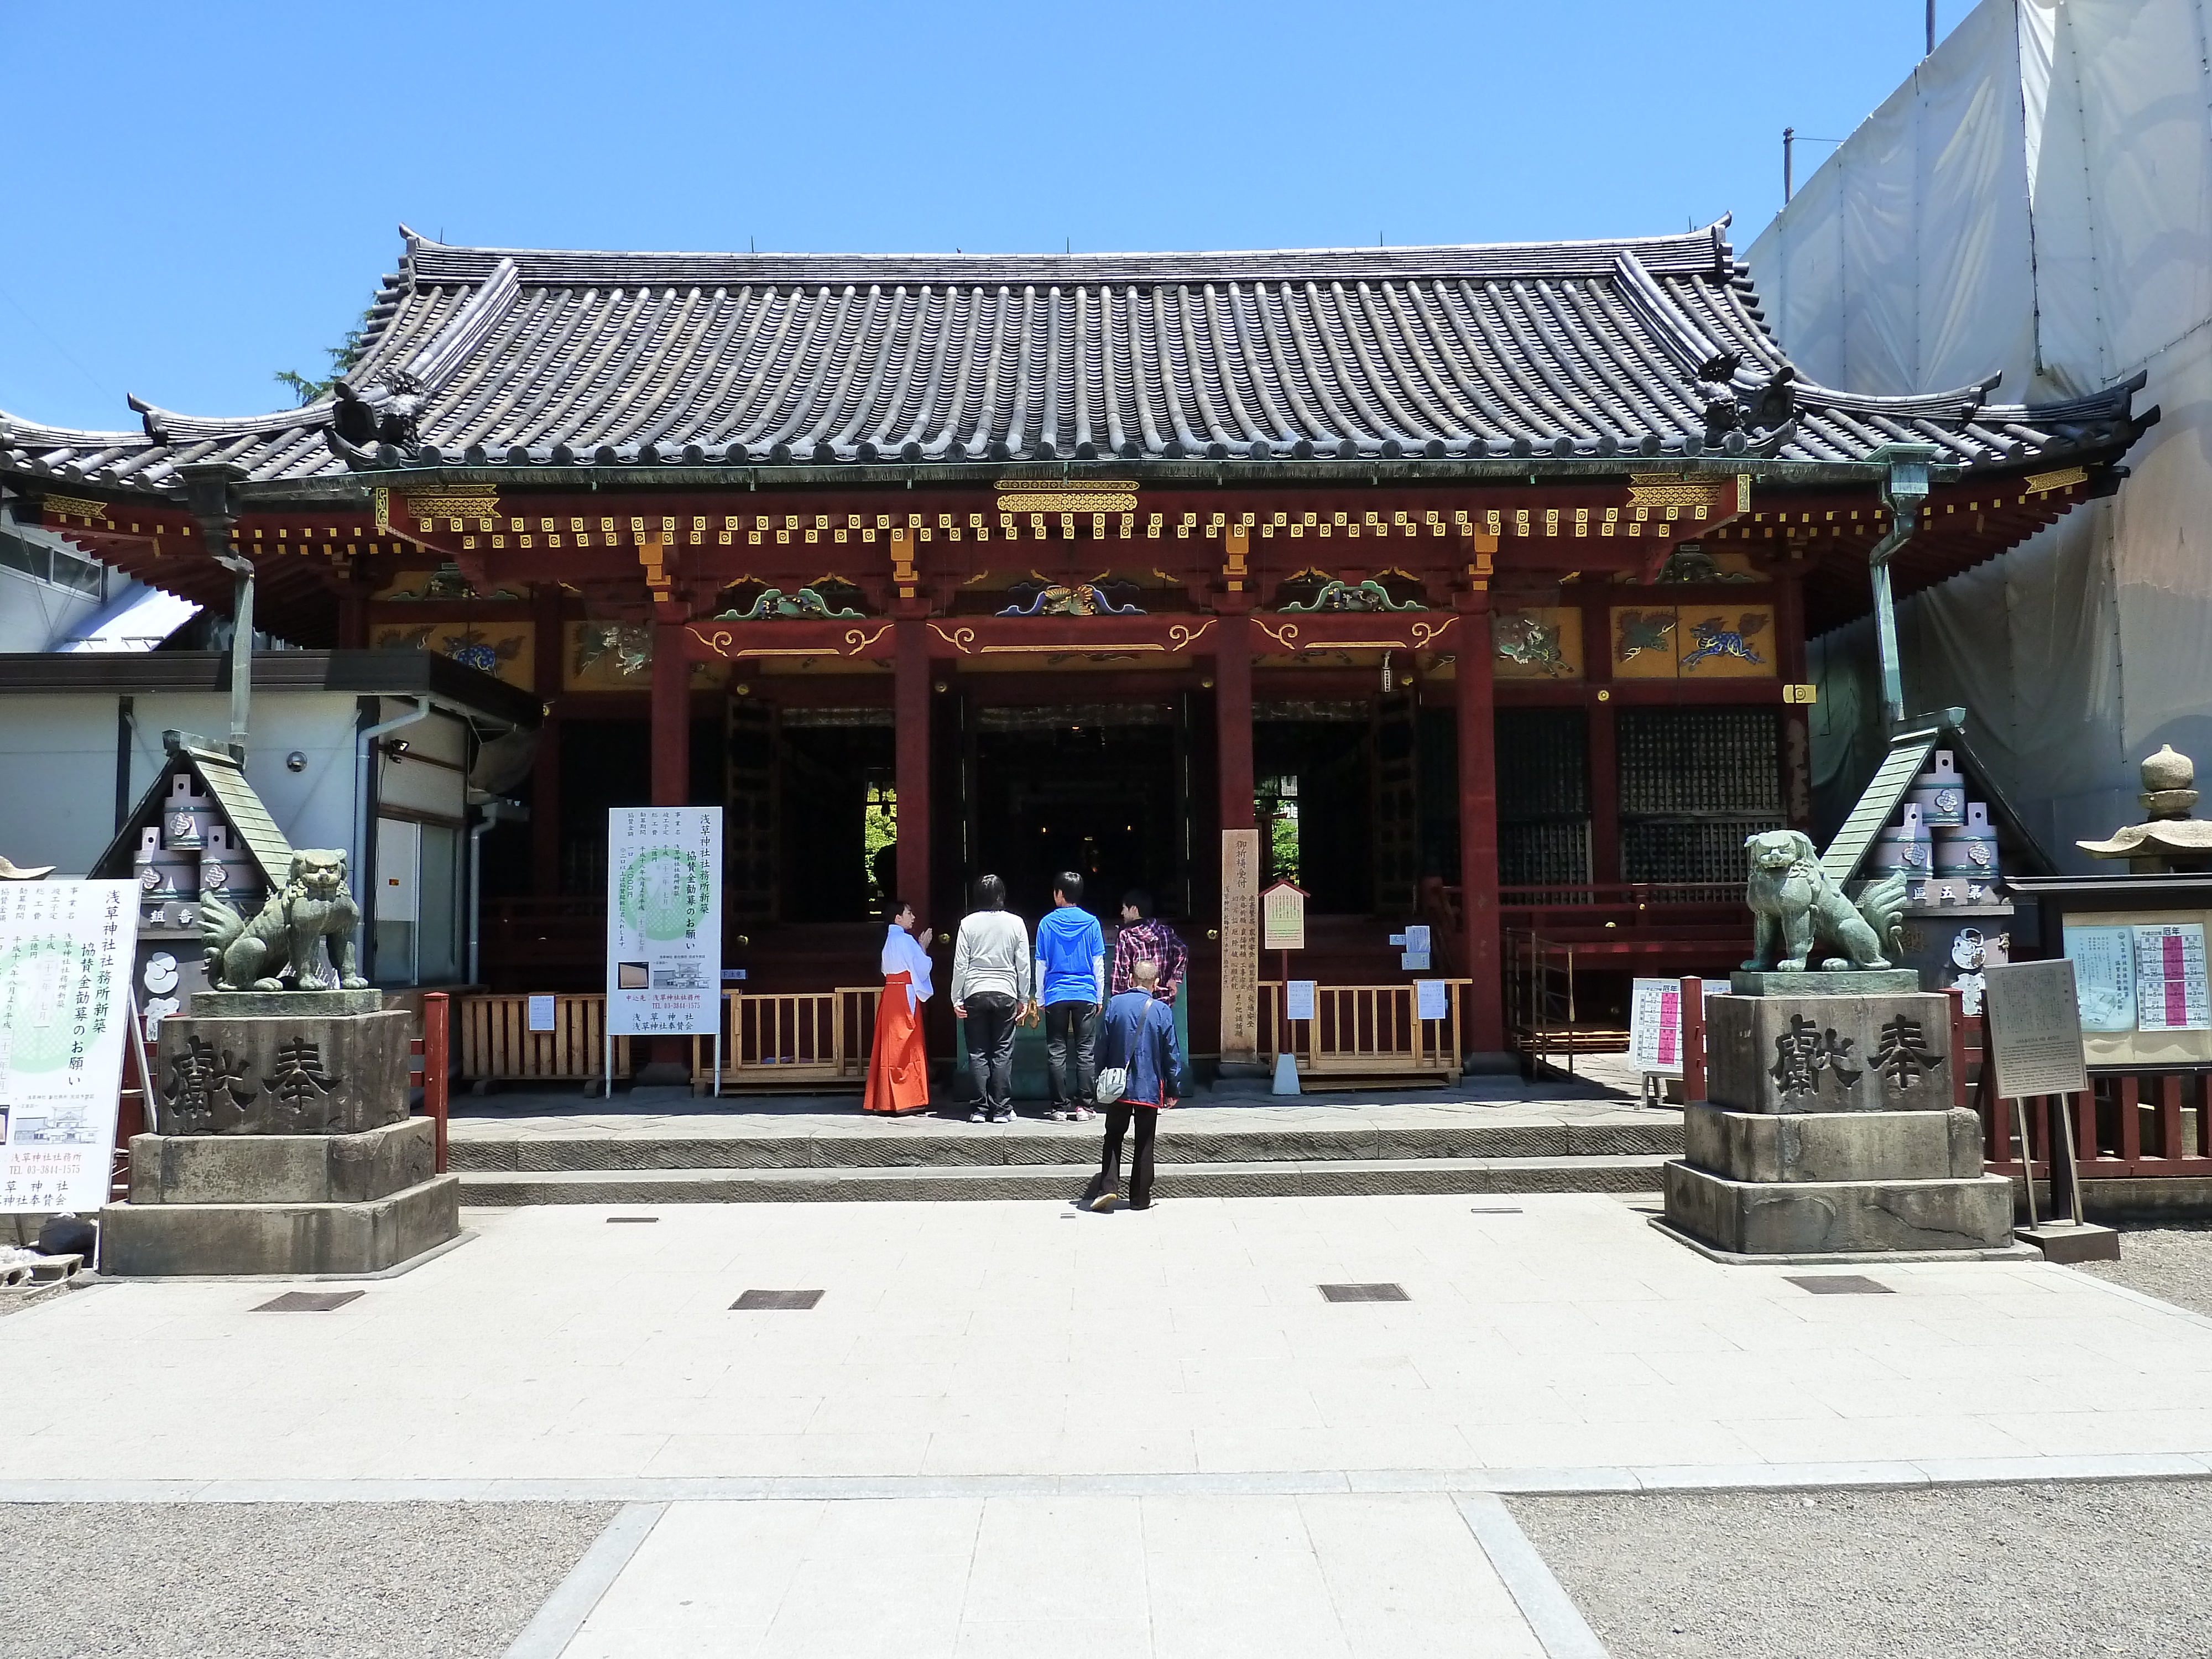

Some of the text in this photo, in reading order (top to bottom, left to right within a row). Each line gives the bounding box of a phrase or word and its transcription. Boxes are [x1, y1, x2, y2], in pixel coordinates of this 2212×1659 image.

[699, 813, 710, 914] 浅草神社社務所新築
[685, 851, 697, 950] 協賛金勧募のお願い
[2163, 927, 2180, 936] 厄年
[92, 889, 121, 1034] 浅草神社社務所新築
[69, 942, 96, 1086] 協賛金勧募のお願い
[632, 1022, 693, 1031] 浅草神社奉賛会
[9, 1165, 81, 1175] TEL 03-3844-1575
[0, 1193, 67, 1207] 神社奉賛会
